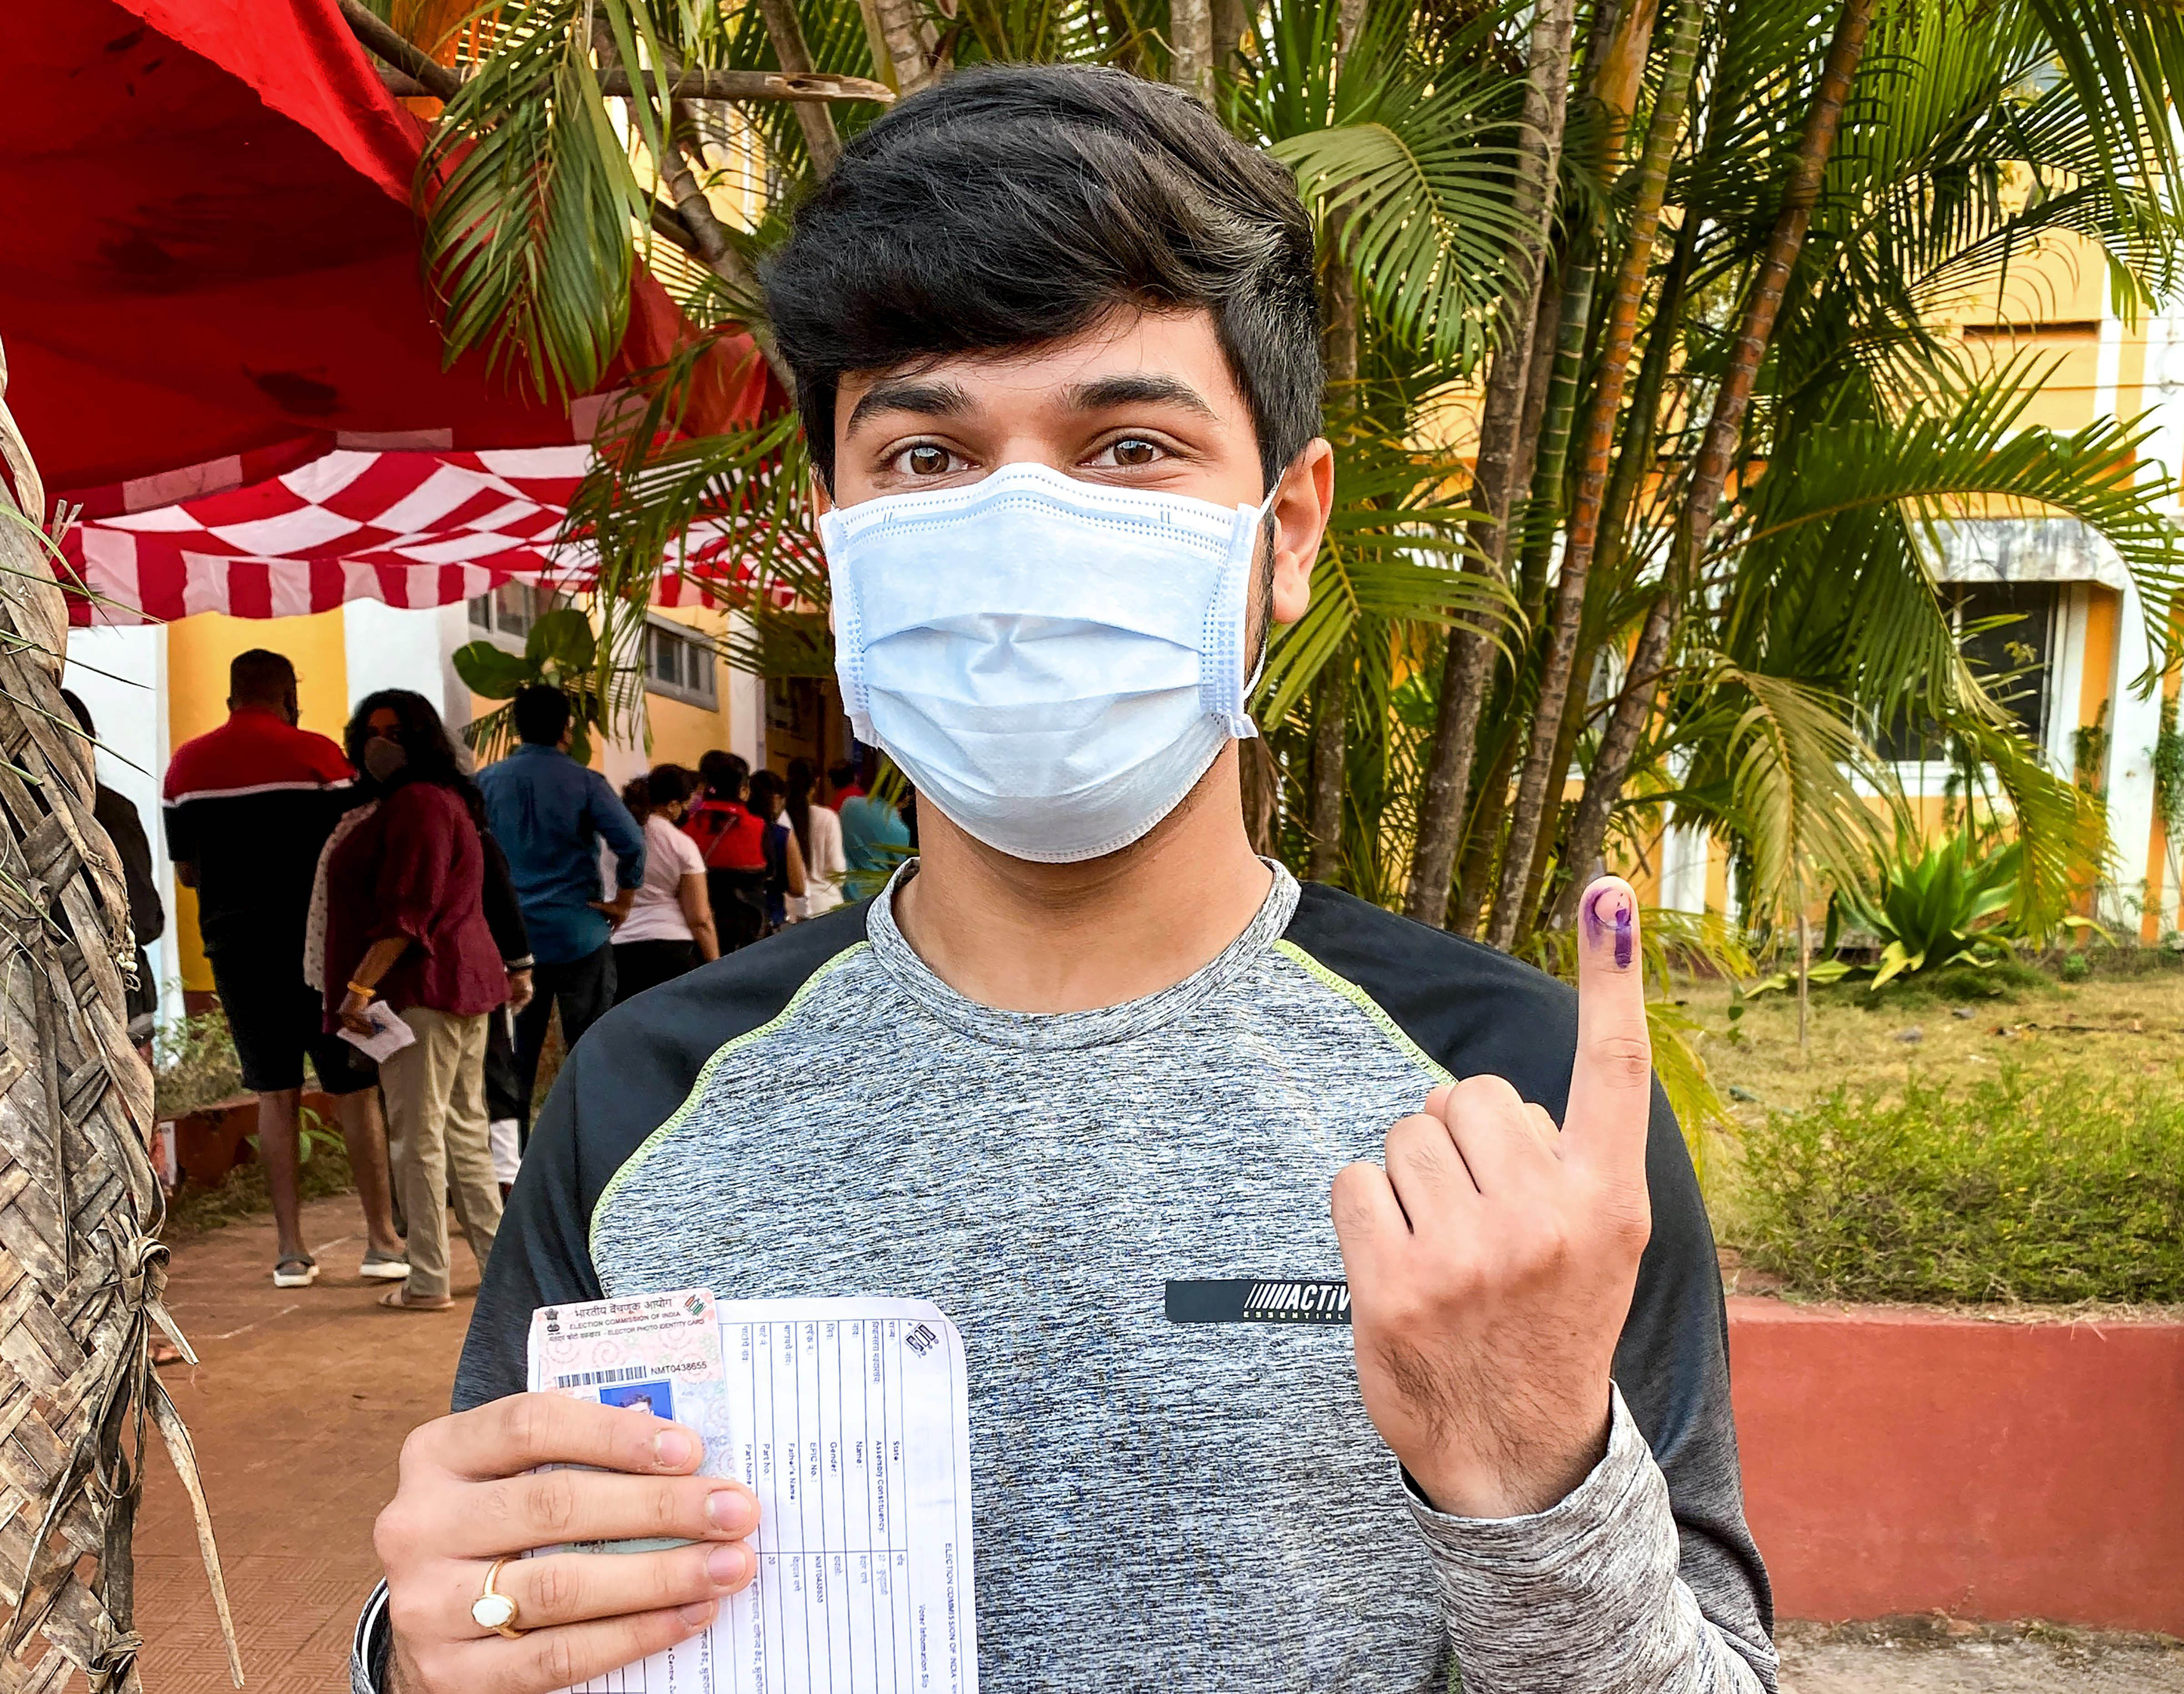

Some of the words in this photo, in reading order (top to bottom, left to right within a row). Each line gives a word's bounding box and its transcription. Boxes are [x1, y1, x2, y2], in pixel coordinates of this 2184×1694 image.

[575, 1306, 607, 1318] भारतीय
[644, 1297, 672, 1309] आयोग
[570, 1321, 603, 1330] ELECTION
[605, 1316, 649, 1325] COMMISSION
[607, 1327, 635, 1336] ELECTOR
[659, 1321, 687, 1329] IDENTITY
[651, 1361, 707, 1375] NMT0438655
[945, 1543, 953, 1584] ELECTION
[946, 1587, 955, 1640] COMMISSION
[949, 1643, 956, 1654] OF
